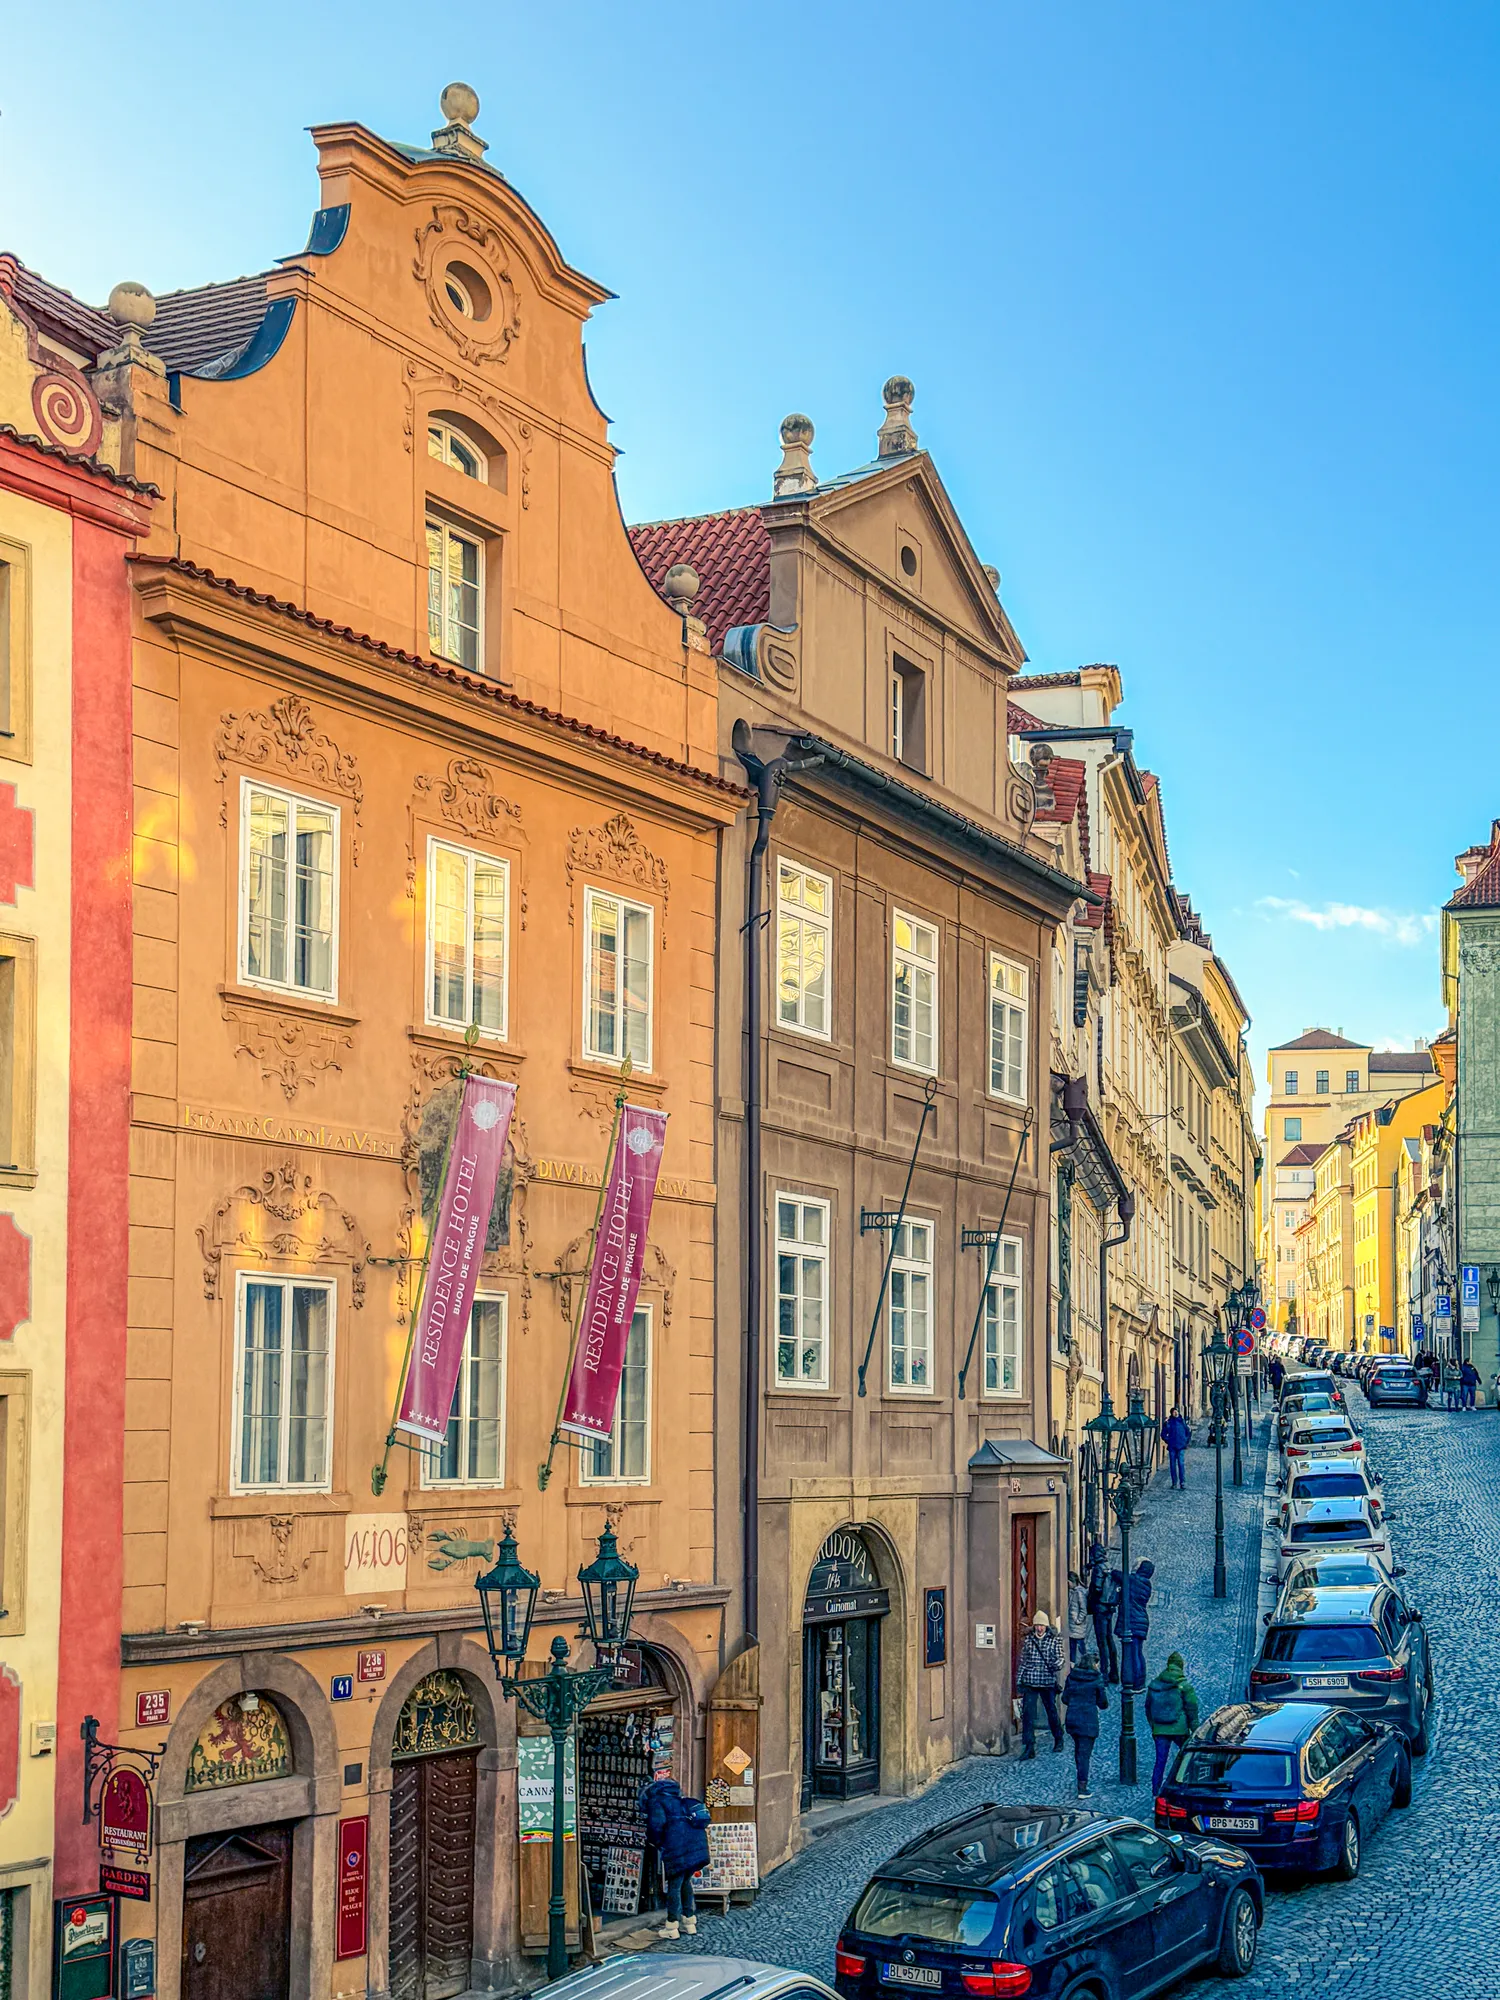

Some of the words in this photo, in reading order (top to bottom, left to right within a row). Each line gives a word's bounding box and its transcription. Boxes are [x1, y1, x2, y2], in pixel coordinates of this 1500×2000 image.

[421, 1235, 461, 1368] RESIDENCE
[449, 1153, 478, 1233] HOTEL
[624, 1232, 638, 1274] PRAGUE
[453, 1282, 465, 1316] BIJOU
[459, 1262, 469, 1279] DE
[464, 1214, 480, 1260] PRAGUE
[584, 1251, 620, 1374] RESIDENCE
[606, 1176, 634, 1249] HOTEL
[621, 1277, 630, 1292] DE
[614, 1294, 626, 1325] BIJOU
[825, 1599, 857, 1613] Curiomat
[366, 1653, 381, 1666] 236
[338, 1680, 349, 1695] 41
[1308, 1677, 1321, 1685] 5SH
[1327, 1677, 1345, 1685] 6909
[145, 1694, 164, 1709] 235
[1211, 1818, 1227, 1827] 8P6
[1233, 1819, 1254, 1828] 4359
[104, 1825, 147, 1841] RESTAURANT
[101, 1867, 147, 1885] GARDEN
[890, 1965, 902, 1978] BL
[907, 1969, 940, 1984] 571DJ
